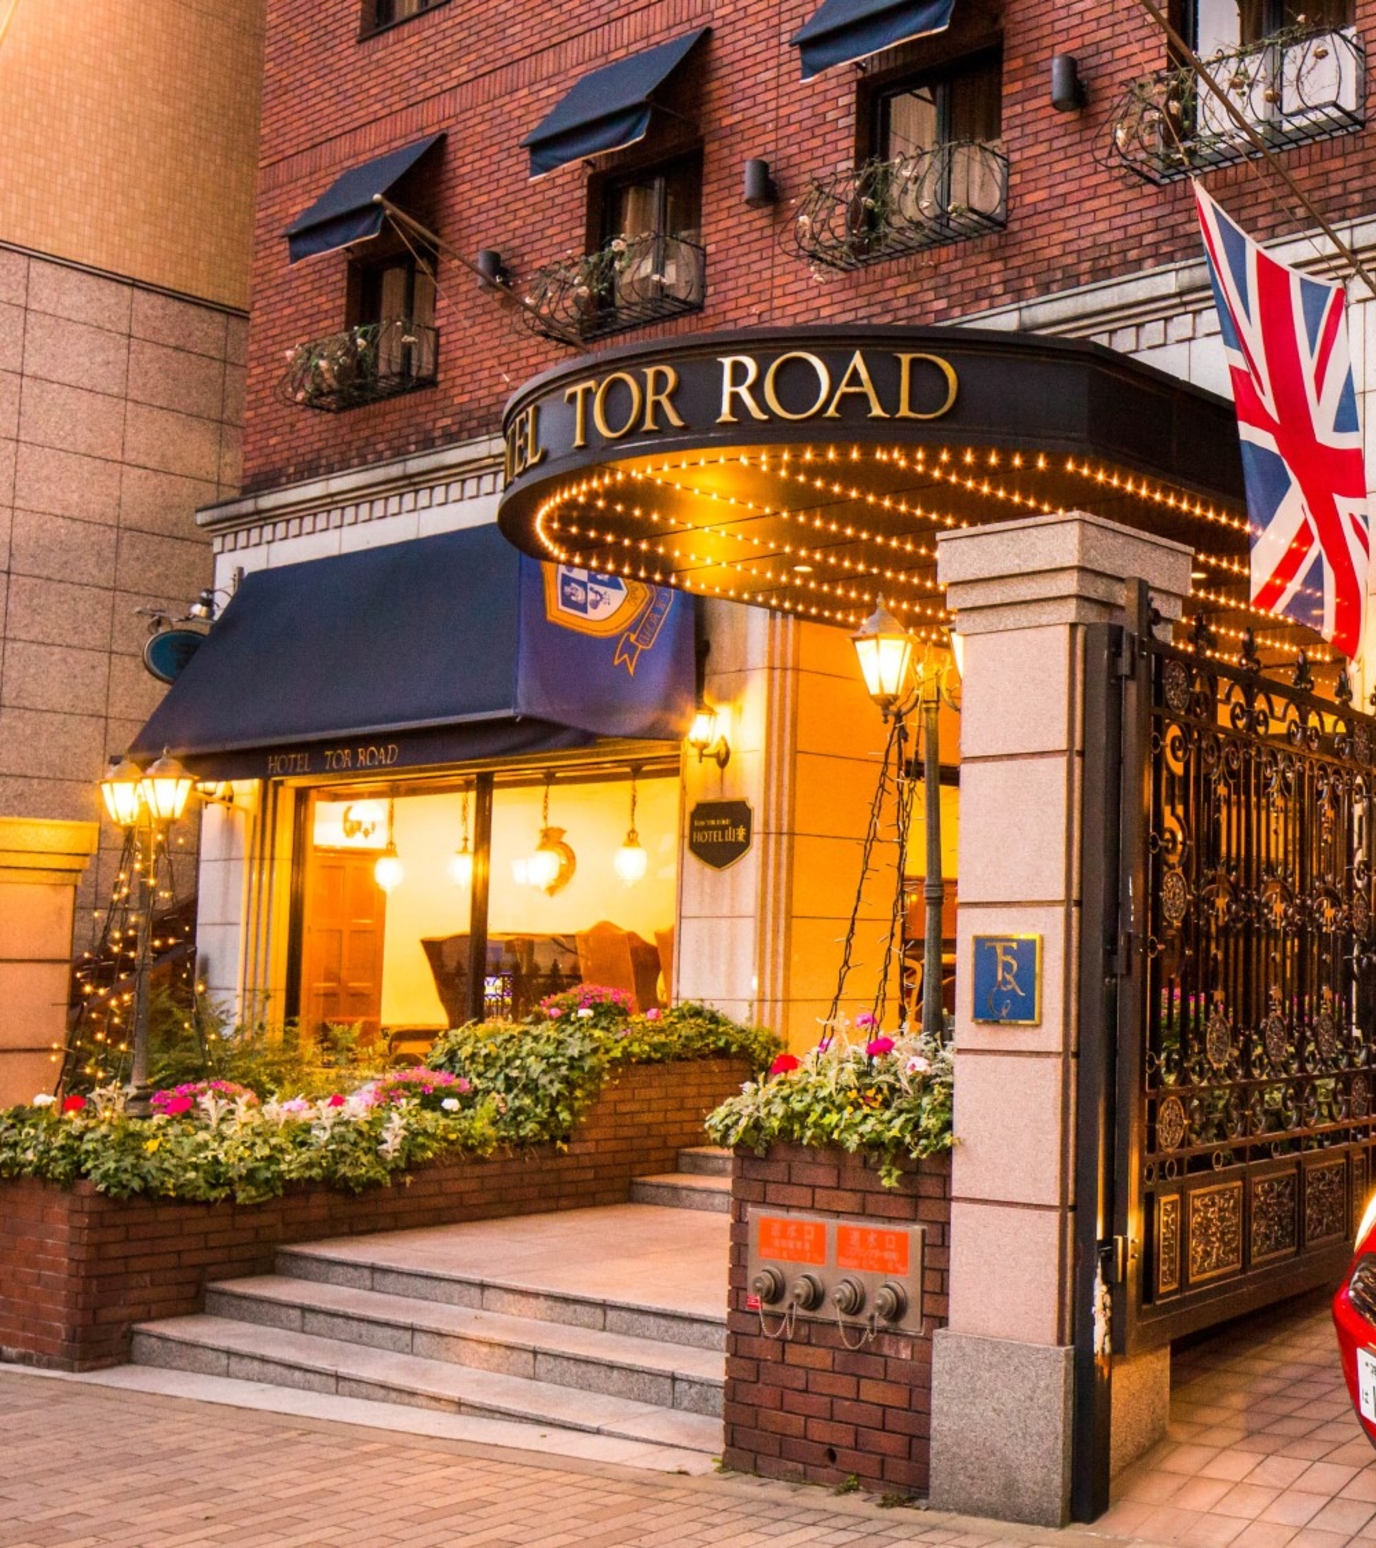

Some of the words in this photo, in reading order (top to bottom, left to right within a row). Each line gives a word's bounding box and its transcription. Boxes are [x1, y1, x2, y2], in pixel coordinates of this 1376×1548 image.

[564, 364, 686, 449] TOR
[715, 349, 959, 424] ROAD
[267, 752, 311, 775] HOTEL
[324, 749, 352, 770] TOR
[357, 743, 399, 768] ROAD
